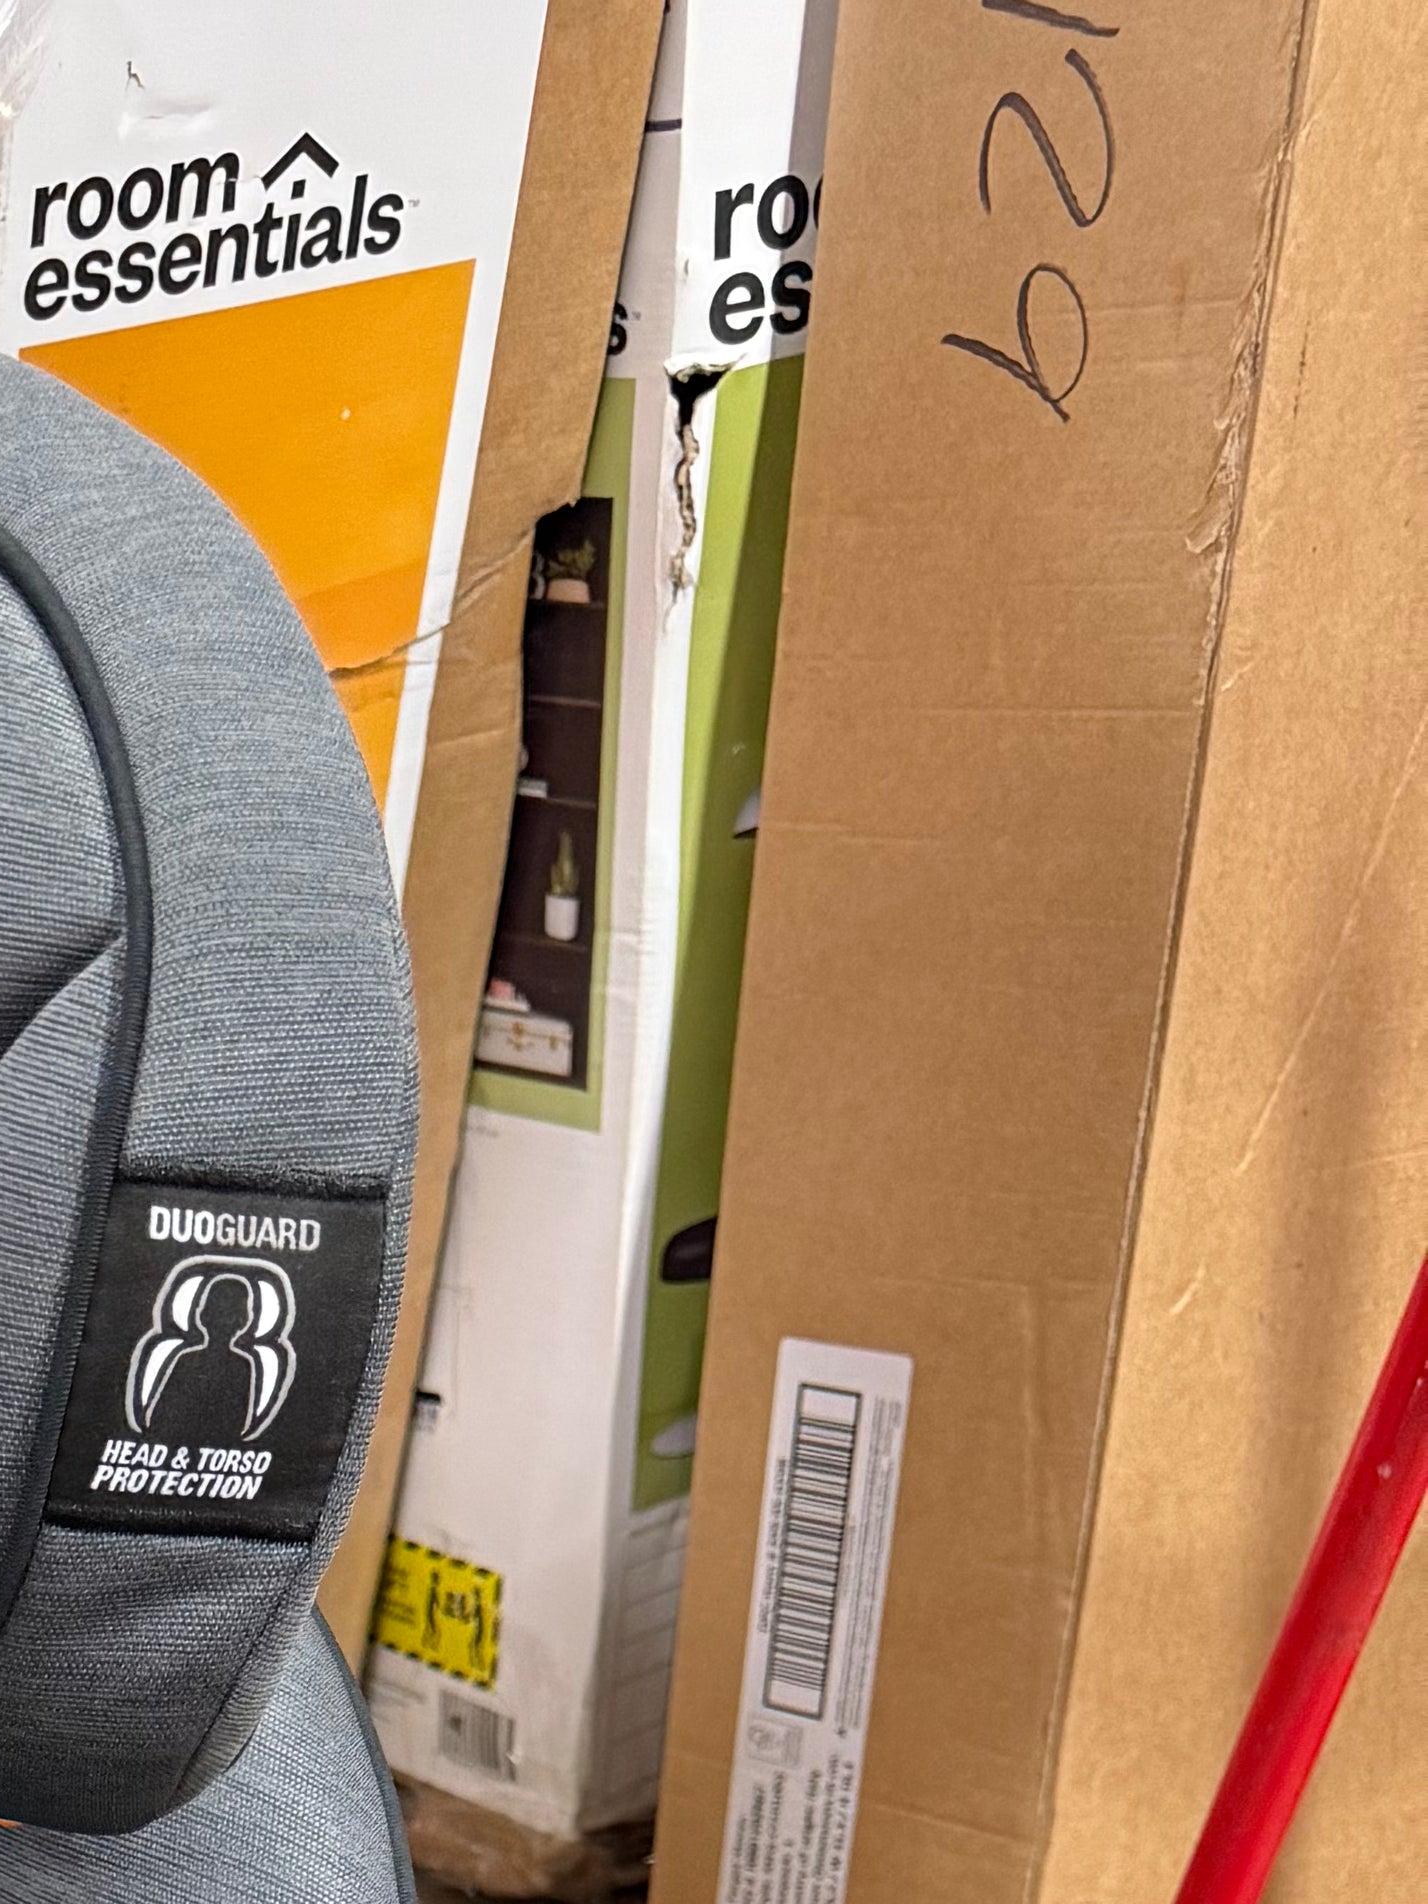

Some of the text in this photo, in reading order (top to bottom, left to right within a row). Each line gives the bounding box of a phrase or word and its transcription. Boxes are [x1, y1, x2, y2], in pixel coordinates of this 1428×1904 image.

[30, 151, 241, 248] room
[713, 174, 824, 261] ro
[148, 1205, 322, 1252] DUOGUARD
[100, 1439, 273, 1475] HEAD & TORSO
[89, 1464, 263, 1500] PROTECTION
